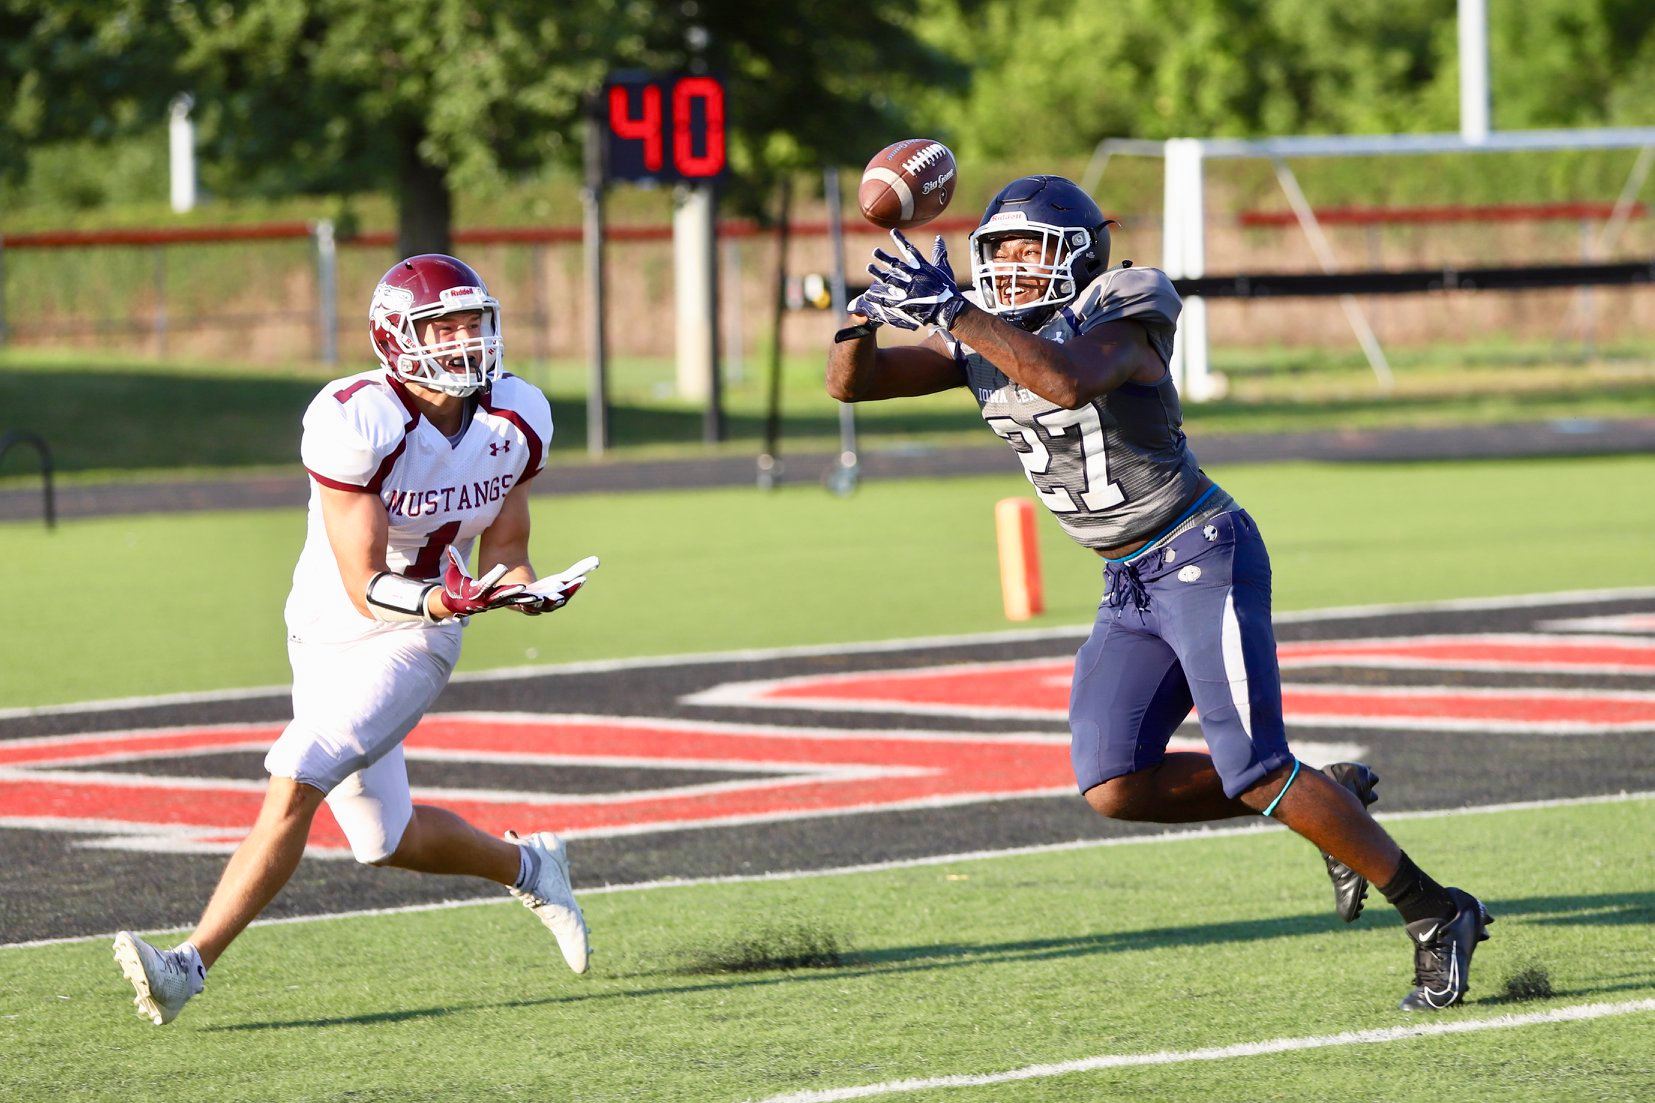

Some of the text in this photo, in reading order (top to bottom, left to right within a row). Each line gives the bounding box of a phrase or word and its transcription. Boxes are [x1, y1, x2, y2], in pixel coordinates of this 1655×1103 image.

[608, 77, 725, 176] 40
[450, 287, 474, 297] Riddell
[978, 387, 1008, 404] IOWA
[985, 405, 1130, 514] 27
[386, 474, 514, 517] MUSTANGS
[402, 520, 462, 579] 1
